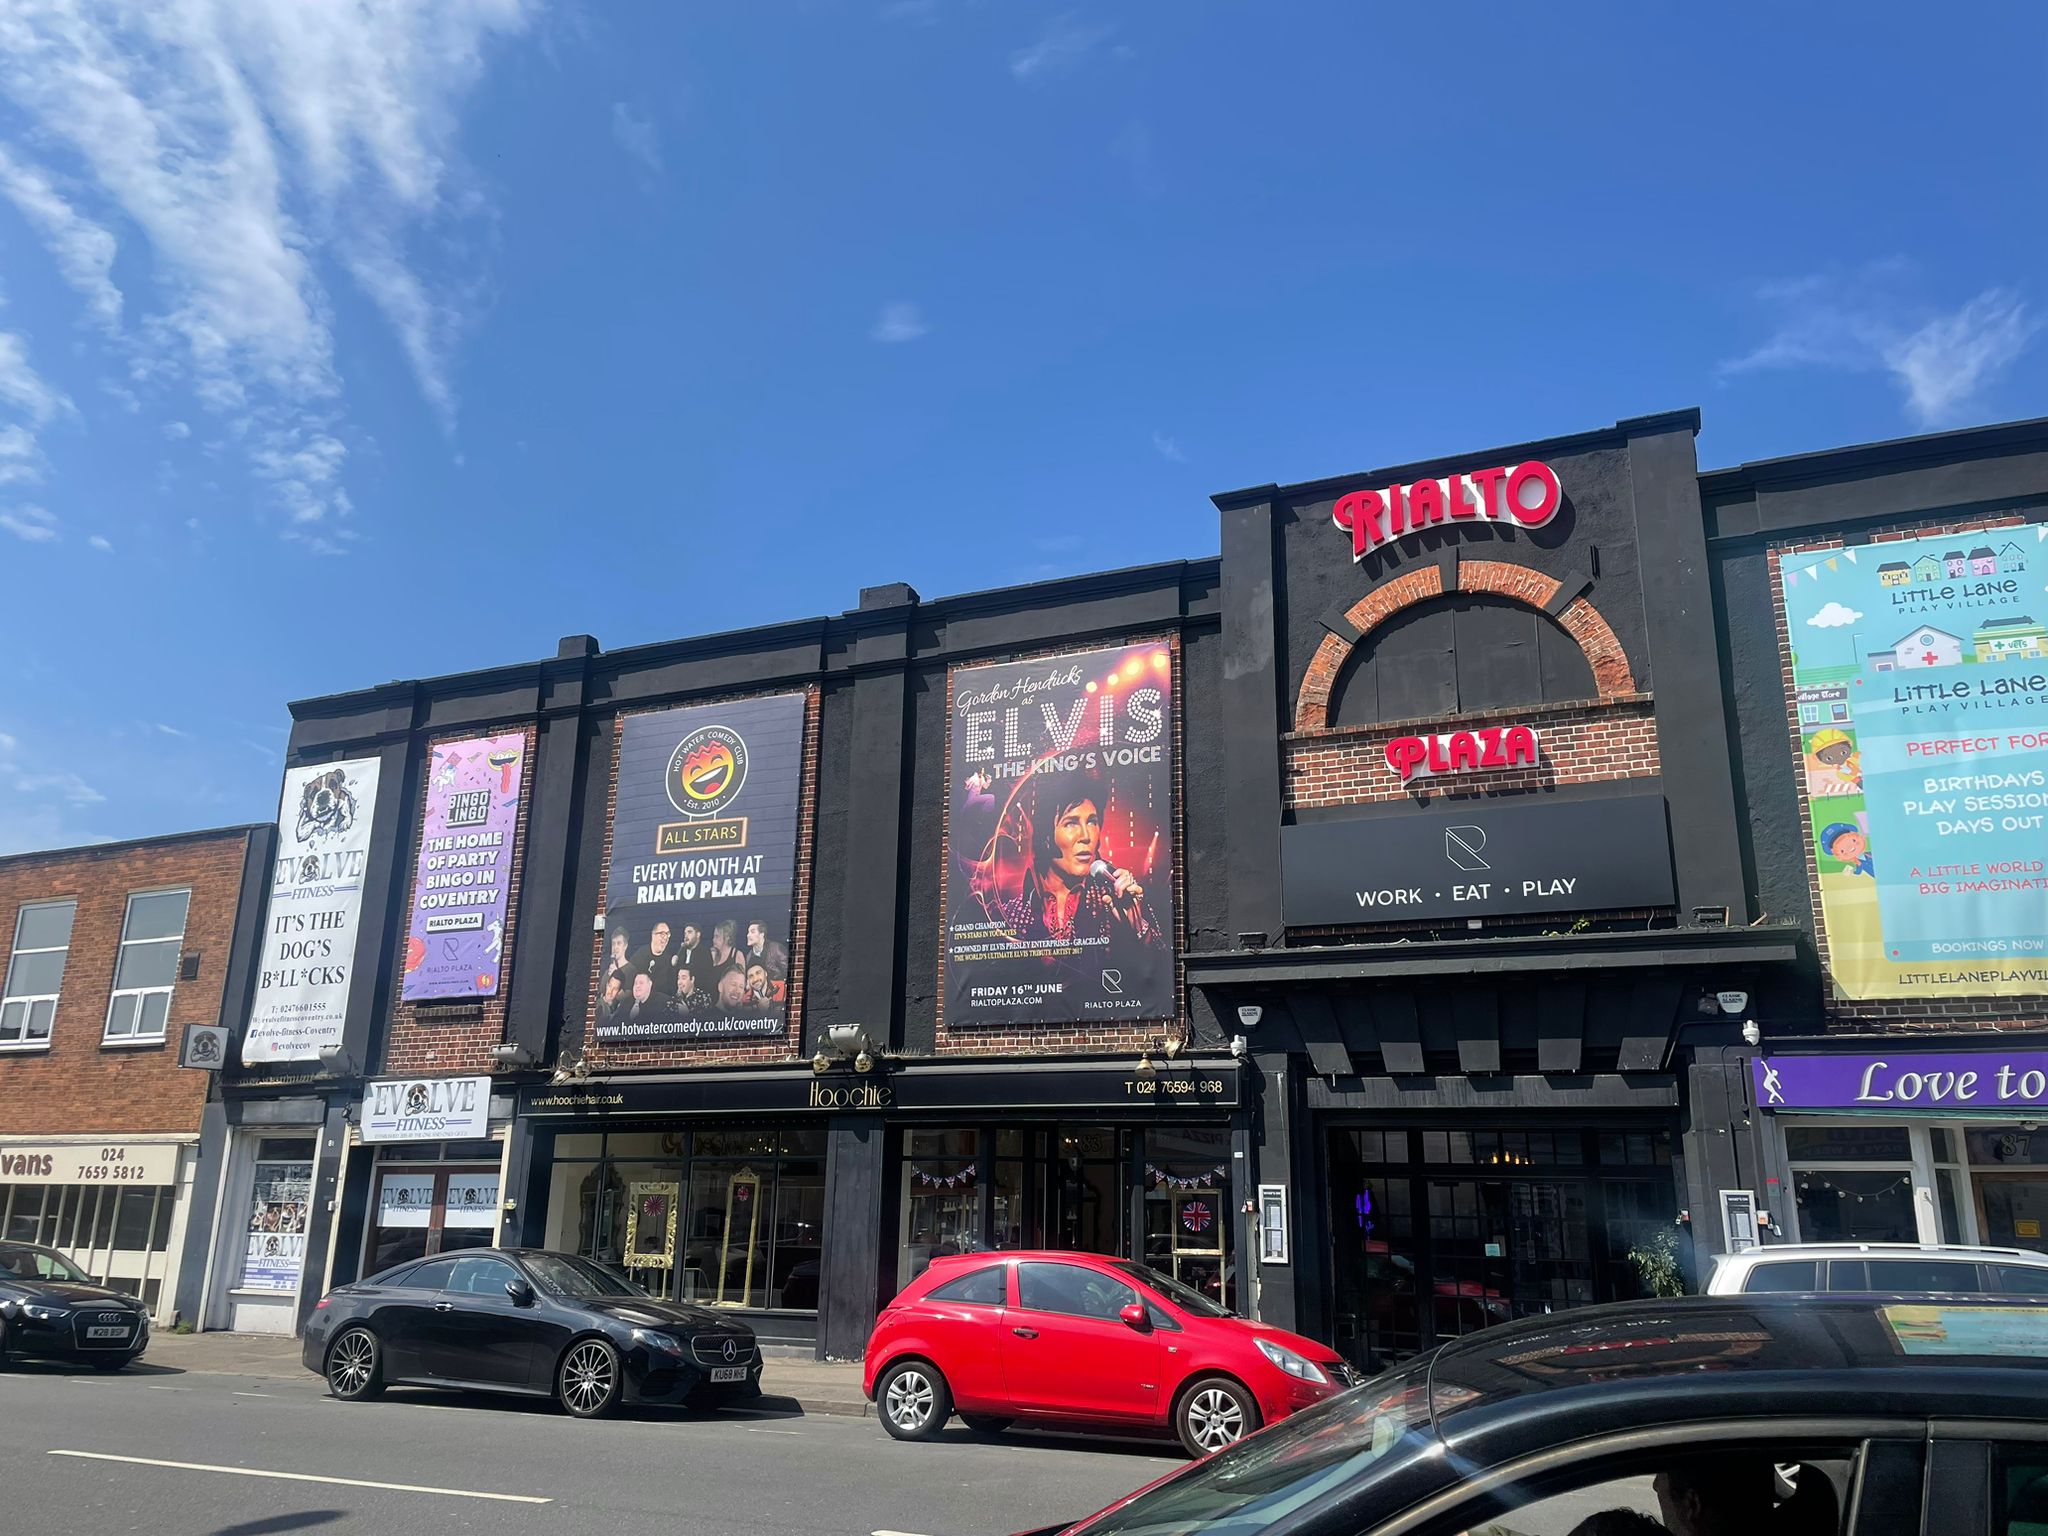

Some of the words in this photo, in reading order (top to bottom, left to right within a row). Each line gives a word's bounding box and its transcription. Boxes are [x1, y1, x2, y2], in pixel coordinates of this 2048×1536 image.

[1333, 461, 1558, 557] RIALTO
[1899, 604, 1938, 614] PLAY
[1947, 596, 2019, 609] VILLAGE
[956, 684, 1010, 717] Gordon
[1010, 665, 1083, 700] Hendricks
[1021, 695, 1034, 705] as
[1902, 702, 1949, 715] PLAY
[965, 688, 1163, 762] ELVIS
[673, 755, 683, 772] HOT
[682, 735, 704, 753] WATER
[708, 731, 736, 745] COMEDY
[734, 746, 744, 765] CLUB
[1385, 726, 1536, 781] PLAZA
[1906, 737, 1999, 756] PERFECT
[993, 759, 1025, 779] THE
[1031, 752, 1096, 774] KING'S
[1102, 746, 1161, 767] VOICE
[1923, 770, 2045, 793] BIRTHDAYS
[449, 791, 489, 809] BINGO
[702, 798, 719, 809] 2010
[1903, 799, 1956, 815] PLAY
[447, 806, 486, 822] LINGO
[1936, 817, 1994, 835] DAYS
[2002, 816, 2043, 831] OUT
[428, 837, 453, 852] THE
[456, 832, 503, 848] HOME
[665, 831, 689, 844] ALL
[694, 826, 737, 841] STARS
[427, 856, 445, 870] OF
[448, 851, 498, 868] PARTY
[633, 862, 678, 883] EVERY
[680, 857, 739, 878] MONTH
[743, 855, 763, 873] AT
[1910, 867, 1922, 878] A
[1928, 864, 1981, 877] LITTLE
[1986, 861, 2044, 874] WORLD
[426, 871, 474, 889] BINGO
[477, 870, 495, 884] IN
[1919, 882, 1949, 895] BIG
[292, 885, 334, 900] FITNESS
[420, 889, 499, 909] COVENTRY
[637, 882, 696, 904] RIALTO
[700, 877, 757, 898] PLAZA
[1356, 888, 1422, 907] WORK
[1453, 884, 1491, 901] EAT
[1523, 878, 1577, 896] PLAY
[275, 914, 305, 934] IT'S
[310, 911, 345, 930] THE
[429, 918, 453, 927] RIALTO
[454, 917, 478, 925] PLAZA
[954, 923, 974, 932] GRAND
[975, 921, 1006, 930] CHAMPION
[280, 939, 331, 960] DOG'S
[954, 945, 981, 953] CROWNED
[990, 942, 1005, 950] ELVIS
[1006, 941, 1030, 950] PRESLEY
[1031, 939, 1070, 948] ENTERPRISES
[1073, 937, 1109, 945] GRACELAND
[1932, 940, 2007, 953] BOOKINGS
[2012, 939, 2044, 949] NOW
[451, 964, 472, 972] PLAZA
[971, 986, 1008, 997] FRIDAY
[1034, 983, 1062, 993] JUNE
[971, 997, 1042, 1007] RIALTOPLAZA.COM
[1085, 1001, 1113, 1009] RIALTO
[1115, 1000, 1141, 1008] PLAZA
[596, 1016, 778, 1037] www.hotwatercomedy.co.uk/coventry
[1124, 1081, 1133, 1094] T
[1136, 1081, 1156, 1094] 024
[1161, 1081, 1196, 1093] 76594
[1200, 1080, 1223, 1093] 968
[1855, 1062, 1978, 1101] Love
[1994, 1064, 2047, 1100] to
[531, 1093, 623, 1106] www.hoochiehair.co.uk
[810, 1080, 891, 1107] Hoochie
[395, 1117, 446, 1131] FITNESS
[101, 1148, 125, 1161] 024
[2000, 1135, 2030, 1156] 87
[1, 1154, 53, 1176] vans
[78, 1166, 108, 1179] 7659
[113, 1166, 144, 1179] 5812
